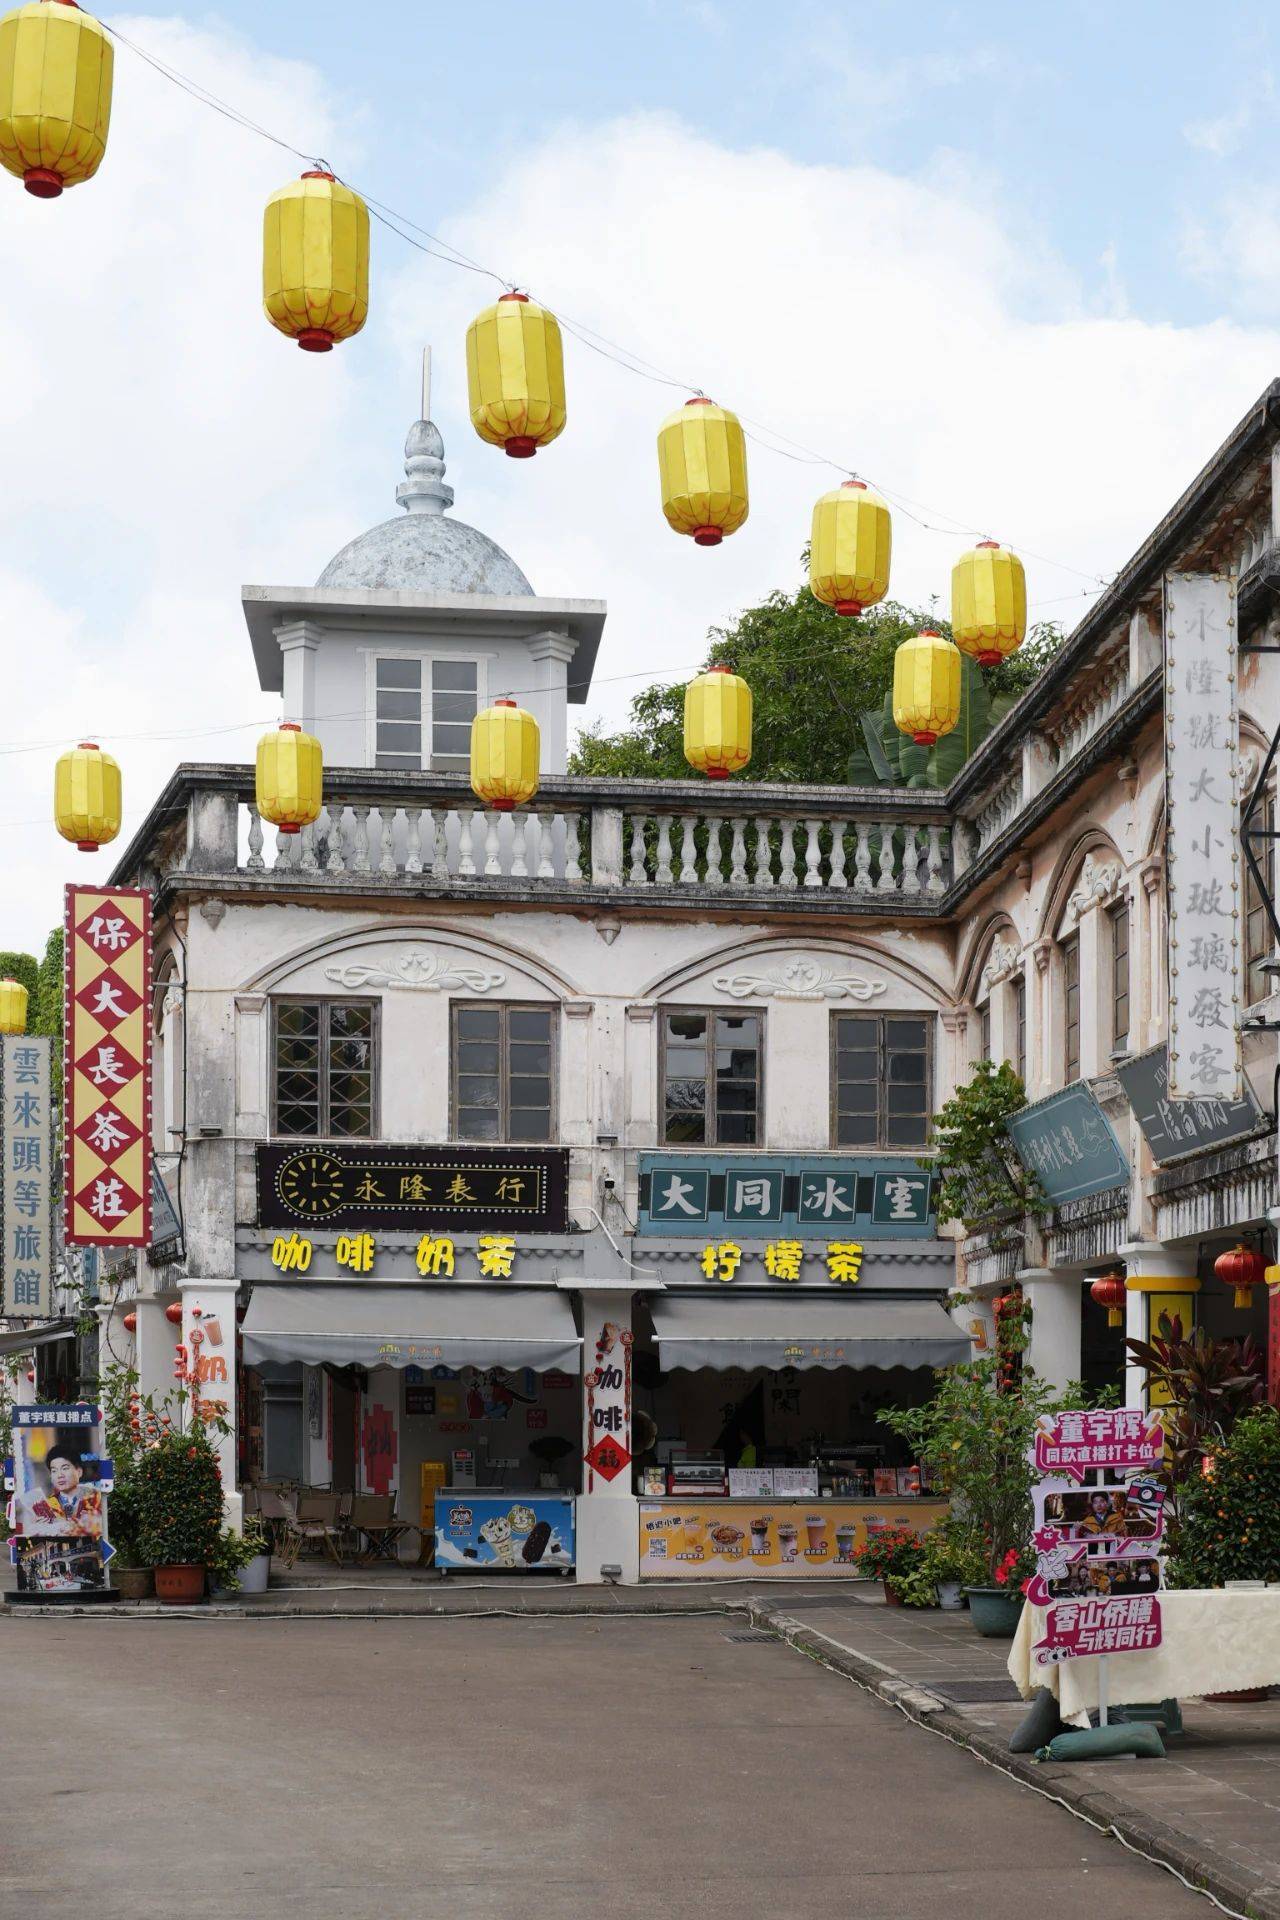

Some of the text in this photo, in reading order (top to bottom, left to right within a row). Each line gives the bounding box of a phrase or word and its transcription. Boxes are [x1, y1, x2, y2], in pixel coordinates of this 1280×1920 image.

[87, 916, 131, 1219] 保大長茶莊
[12, 1047, 41, 1306] 雲來頭等旅館
[354, 1172, 526, 1203] 永隆表行
[657, 1174, 925, 1220] 大同冰室
[700, 1240, 864, 1284] 柠檬茶
[1058, 1411, 1143, 1443] 董宇辉
[1045, 1444, 1155, 1463] 同款直播打卡位
[1054, 1597, 1153, 1632] 香山侨膳
[1075, 1624, 1157, 1652] 与辉同行
